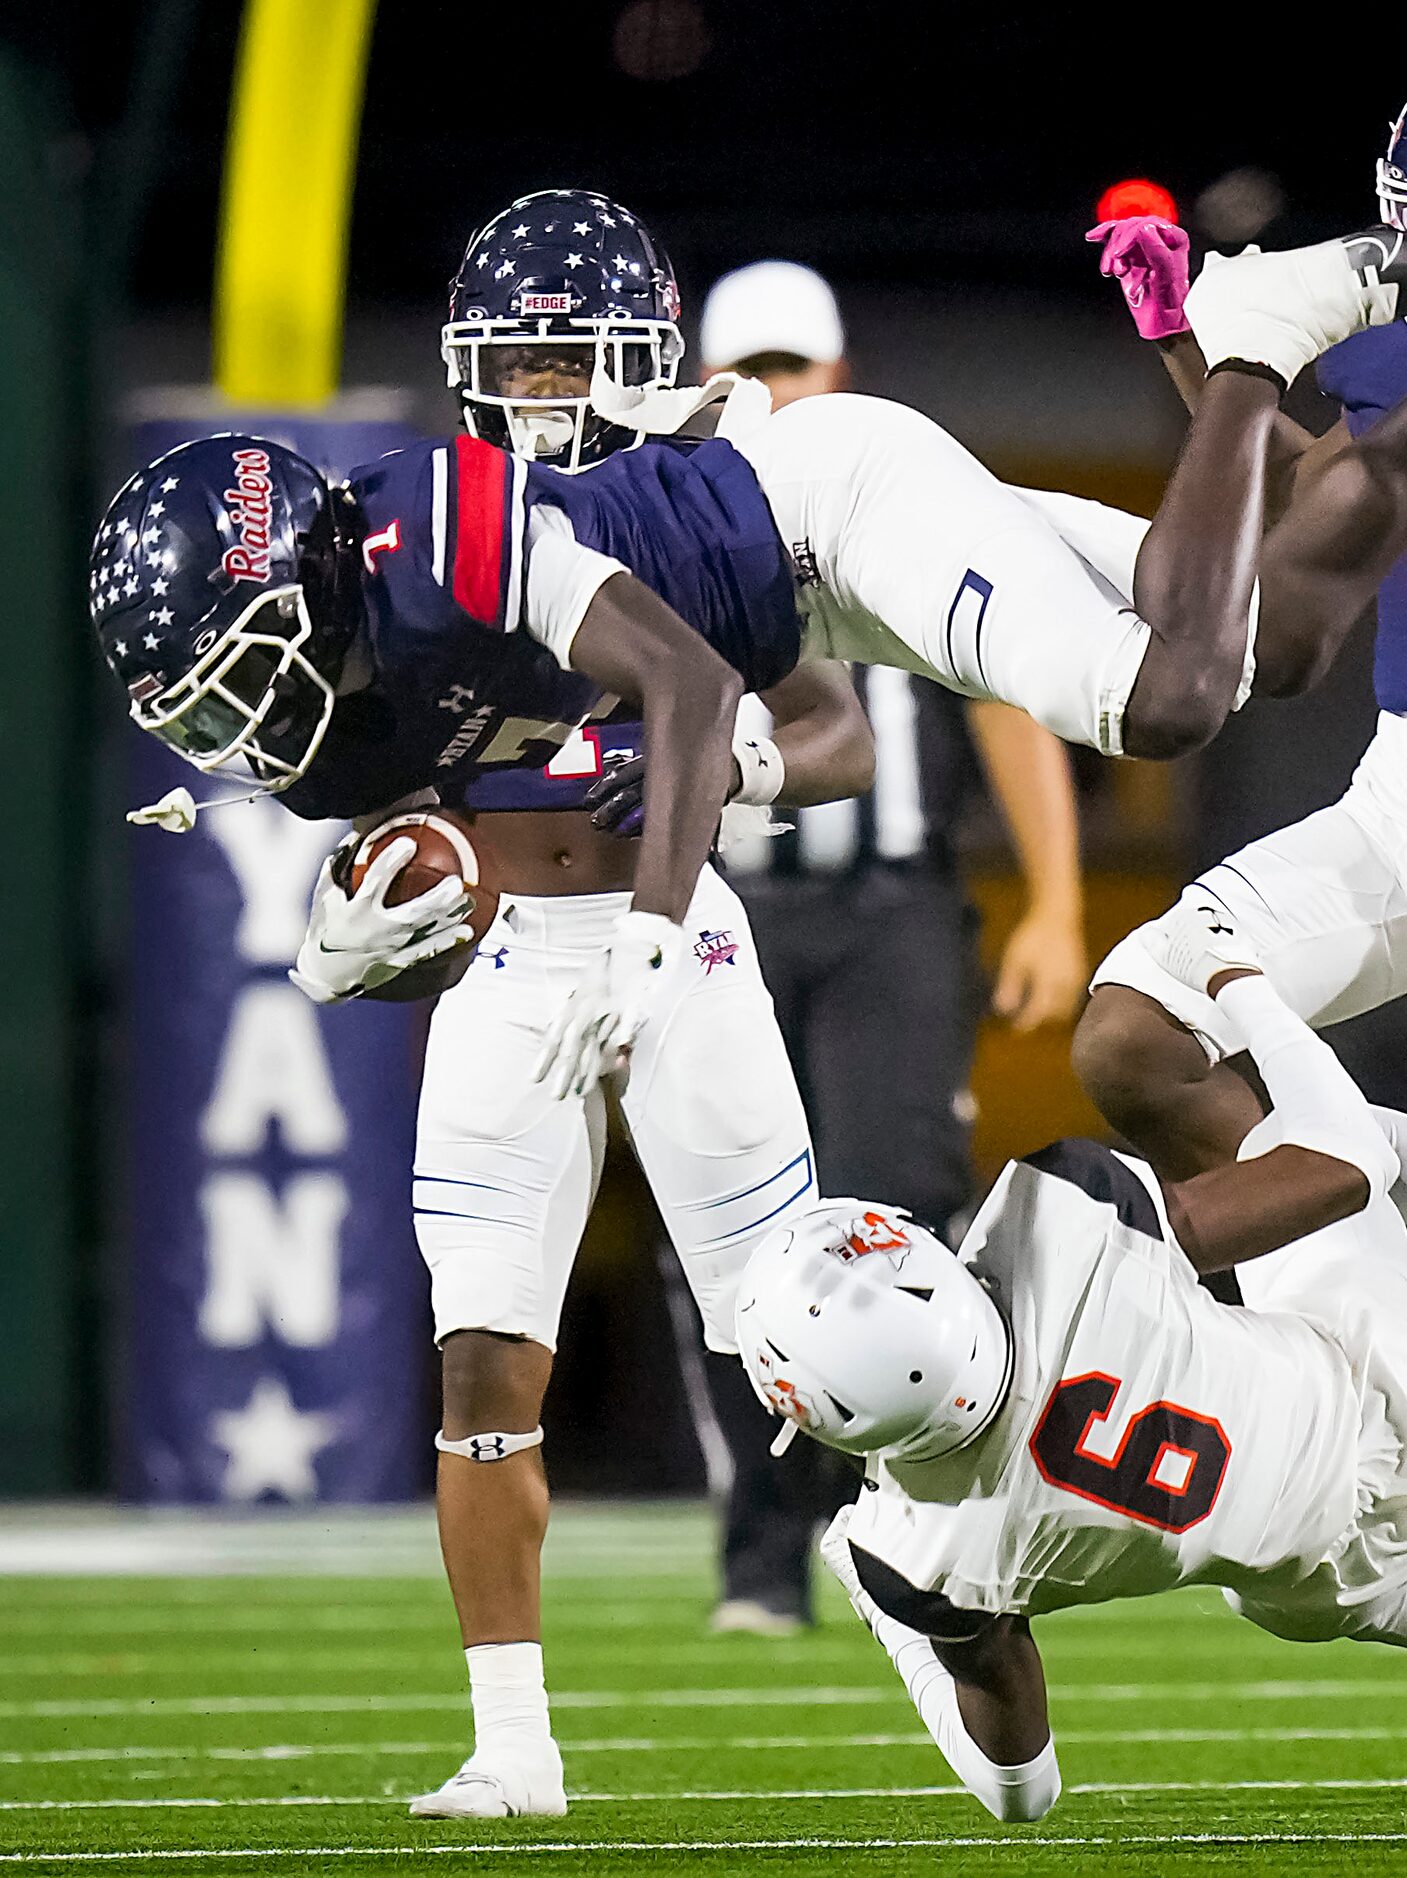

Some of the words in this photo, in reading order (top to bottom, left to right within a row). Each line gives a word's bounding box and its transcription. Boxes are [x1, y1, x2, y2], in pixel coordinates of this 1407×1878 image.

[525, 297, 567, 309] #EDGE
[221, 448, 273, 584] Raiders
[694, 931, 737, 960] RYAN
[1030, 1371, 1233, 1534] 6
